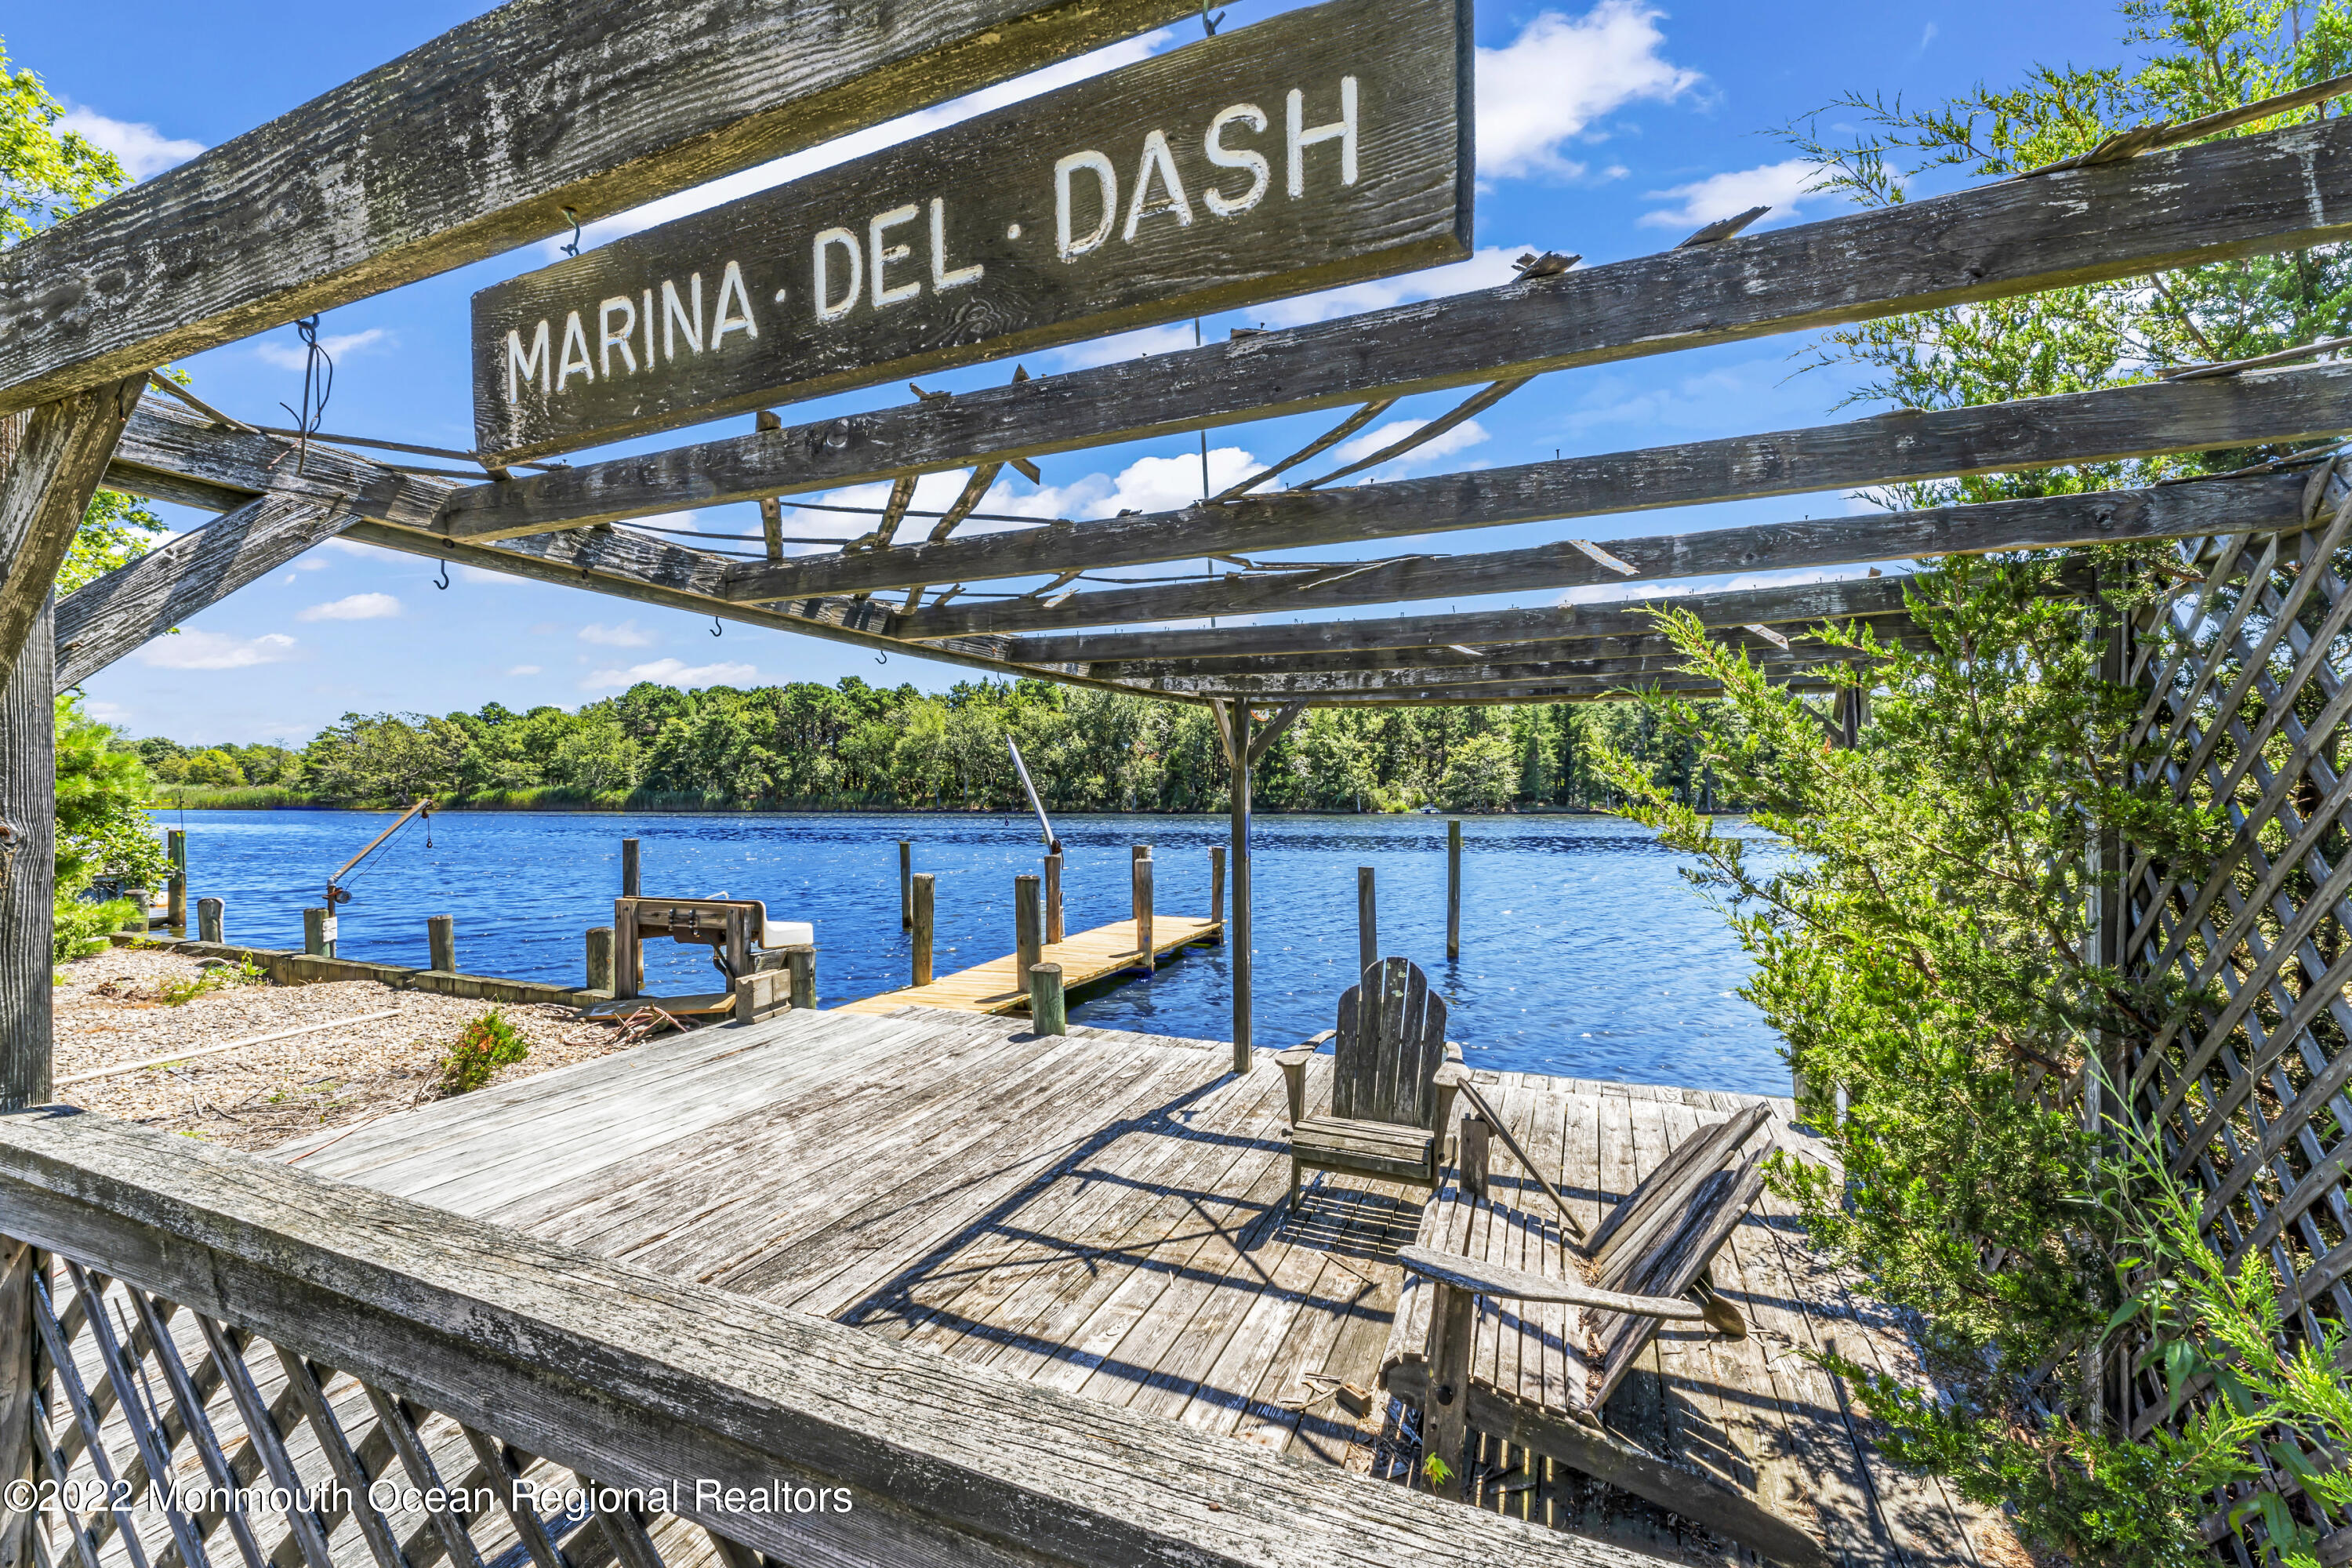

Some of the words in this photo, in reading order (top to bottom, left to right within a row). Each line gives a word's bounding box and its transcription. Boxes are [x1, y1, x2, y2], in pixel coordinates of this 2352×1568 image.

[507, 260, 758, 404] MARINA
[813, 197, 985, 325] DEL
[1054, 75, 1359, 260] DASH
